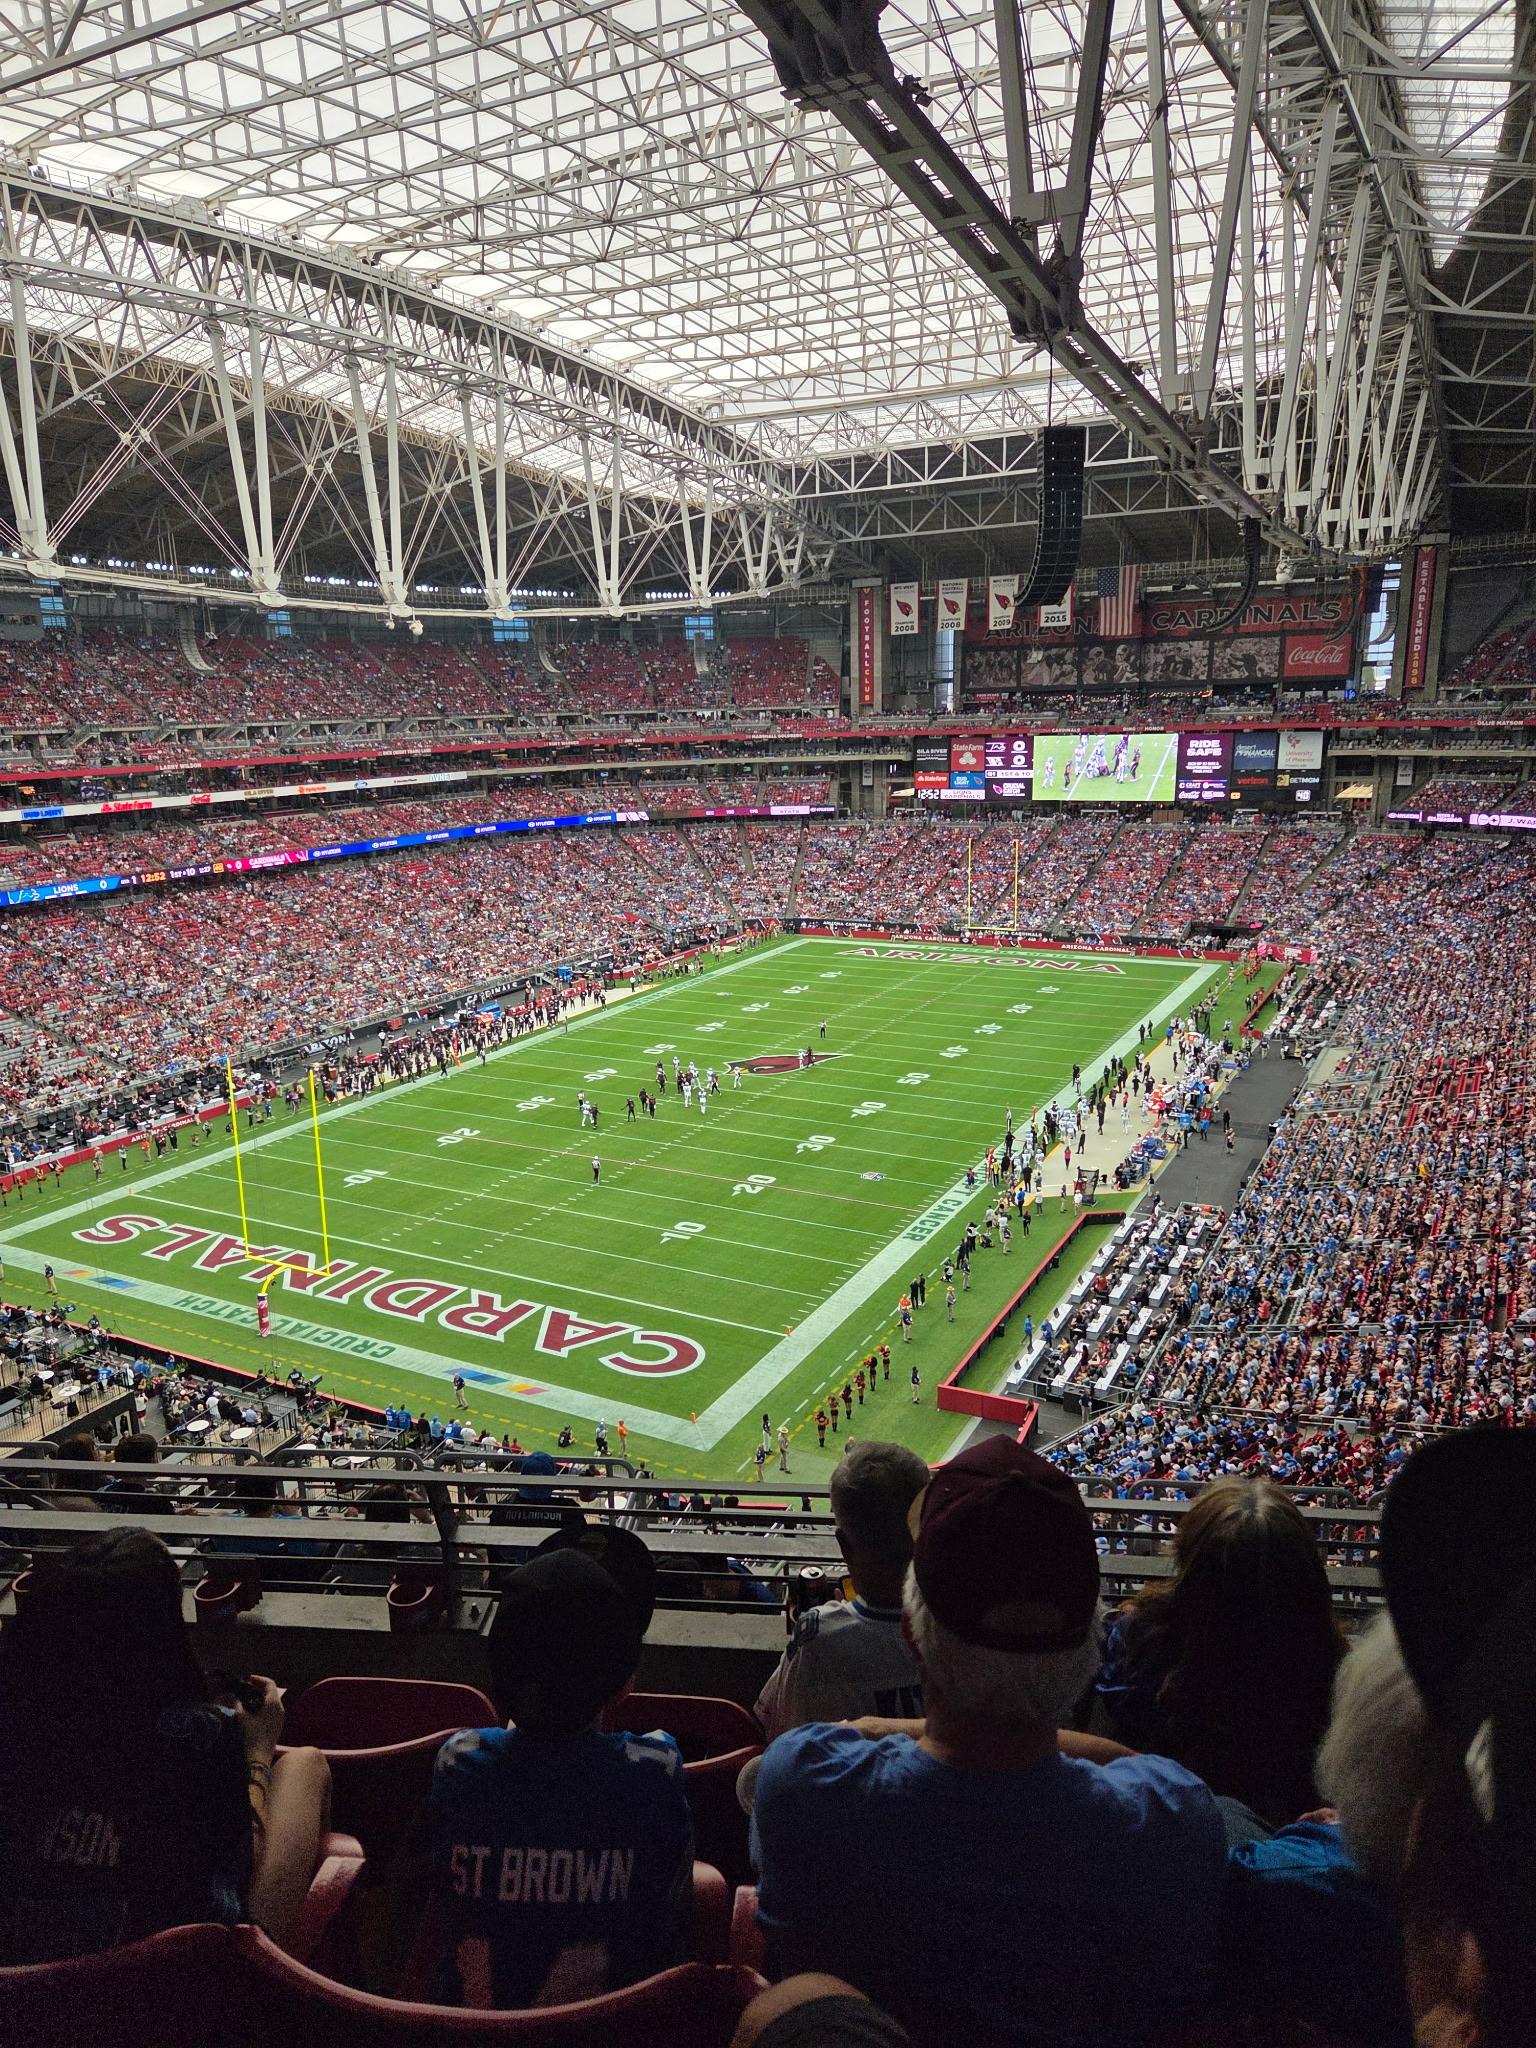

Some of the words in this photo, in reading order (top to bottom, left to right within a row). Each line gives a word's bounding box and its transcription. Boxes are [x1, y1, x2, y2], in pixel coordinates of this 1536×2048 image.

[1413, 561, 1429, 650] ESTABLISHED
[1044, 615, 1067, 623] 2015
[1287, 645, 1345, 665] Coca-Cola
[1410, 652, 1420, 684] 1898
[1187, 747, 1222, 756] SAFE
[1189, 739, 1220, 748] RIDE
[1235, 749, 1275, 757] FINANCIAL
[917, 789, 939, 799] 12:52
[53, 884, 78, 894] LIONS
[99, 880, 107, 889] 0
[131, 875, 137, 884] 1
[140, 871, 166, 884] 12:52
[169, 870, 182, 878] 1ST
[186, 867, 195, 876] 10
[235, 860, 242, 869] 0
[248, 854, 286, 866] CARDINALS
[835, 947, 1127, 975] ARIZONA
[1036, 986, 1060, 994] 10
[1006, 1004, 1033, 1014] 20
[974, 1024, 1003, 1035] 30
[643, 1043, 677, 1054] 50
[939, 1045, 968, 1058] 40
[583, 1068, 618, 1080] 40
[896, 1072, 931, 1085] 50
[516, 1095, 556, 1109] 30
[853, 1101, 887, 1116] 40
[436, 1128, 481, 1144] 20
[798, 1135, 836, 1151] 30
[343, 1168, 389, 1184] 10
[735, 1174, 777, 1194] 20
[902, 1198, 963, 1242] CANCER
[663, 1221, 707, 1240] 10
[70, 1214, 706, 1378] CARDINALS
[172, 1295, 259, 1325] CATCH
[270, 1317, 396, 1359] CRUCIAL
[450, 1844, 492, 1898] ST
[498, 1847, 634, 1903] BROWN
